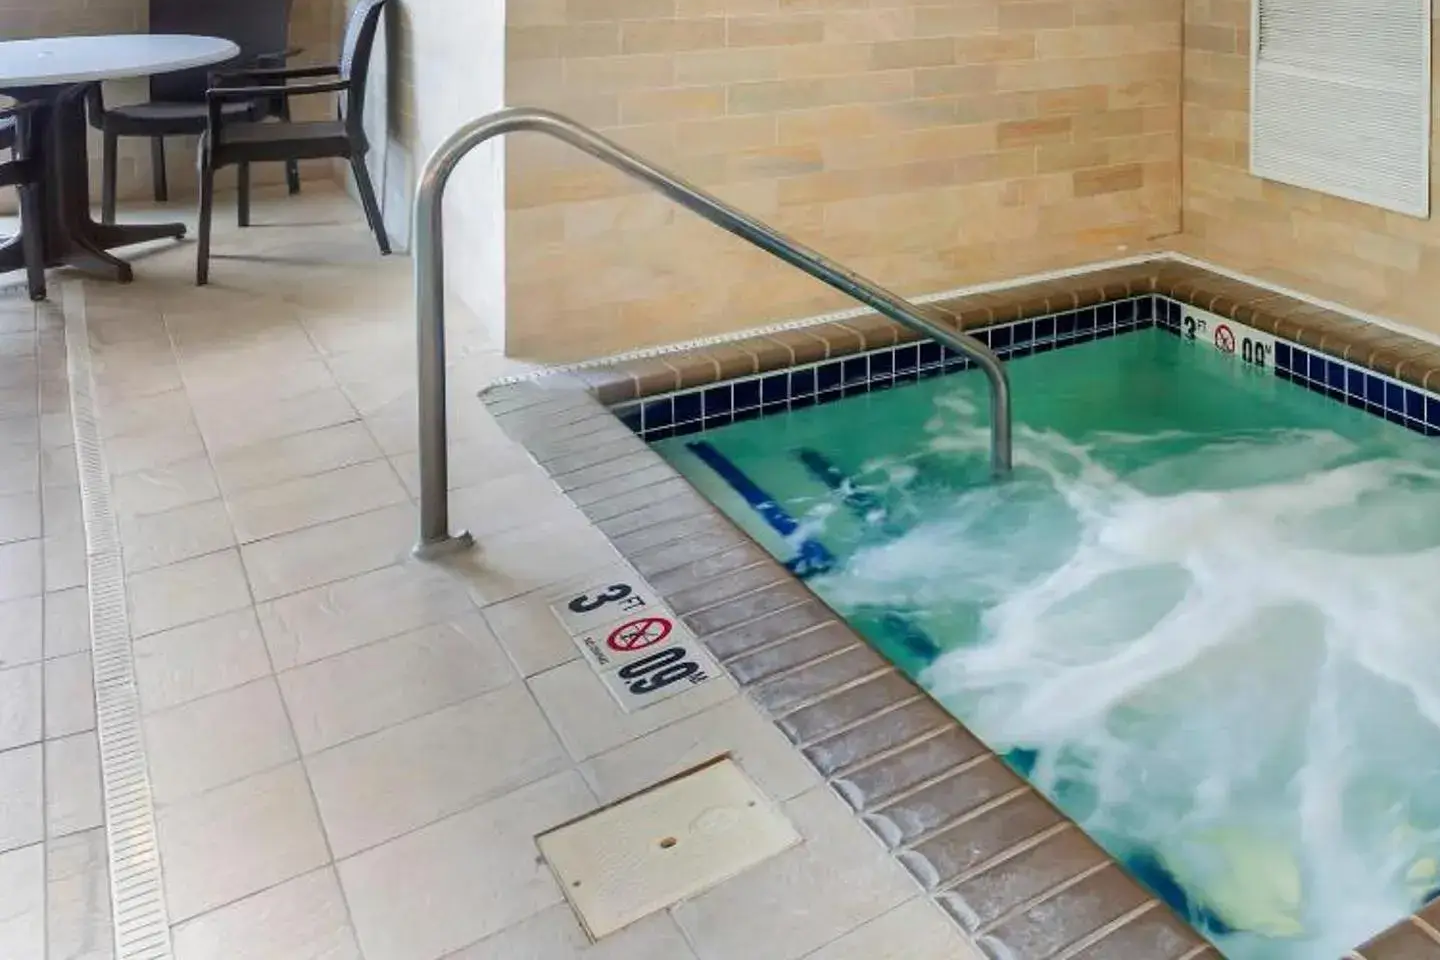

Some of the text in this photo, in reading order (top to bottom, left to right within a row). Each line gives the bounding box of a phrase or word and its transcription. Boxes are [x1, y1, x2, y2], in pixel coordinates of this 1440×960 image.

[568, 583, 647, 613] 3 FT
[618, 647, 700, 695] 0.9
